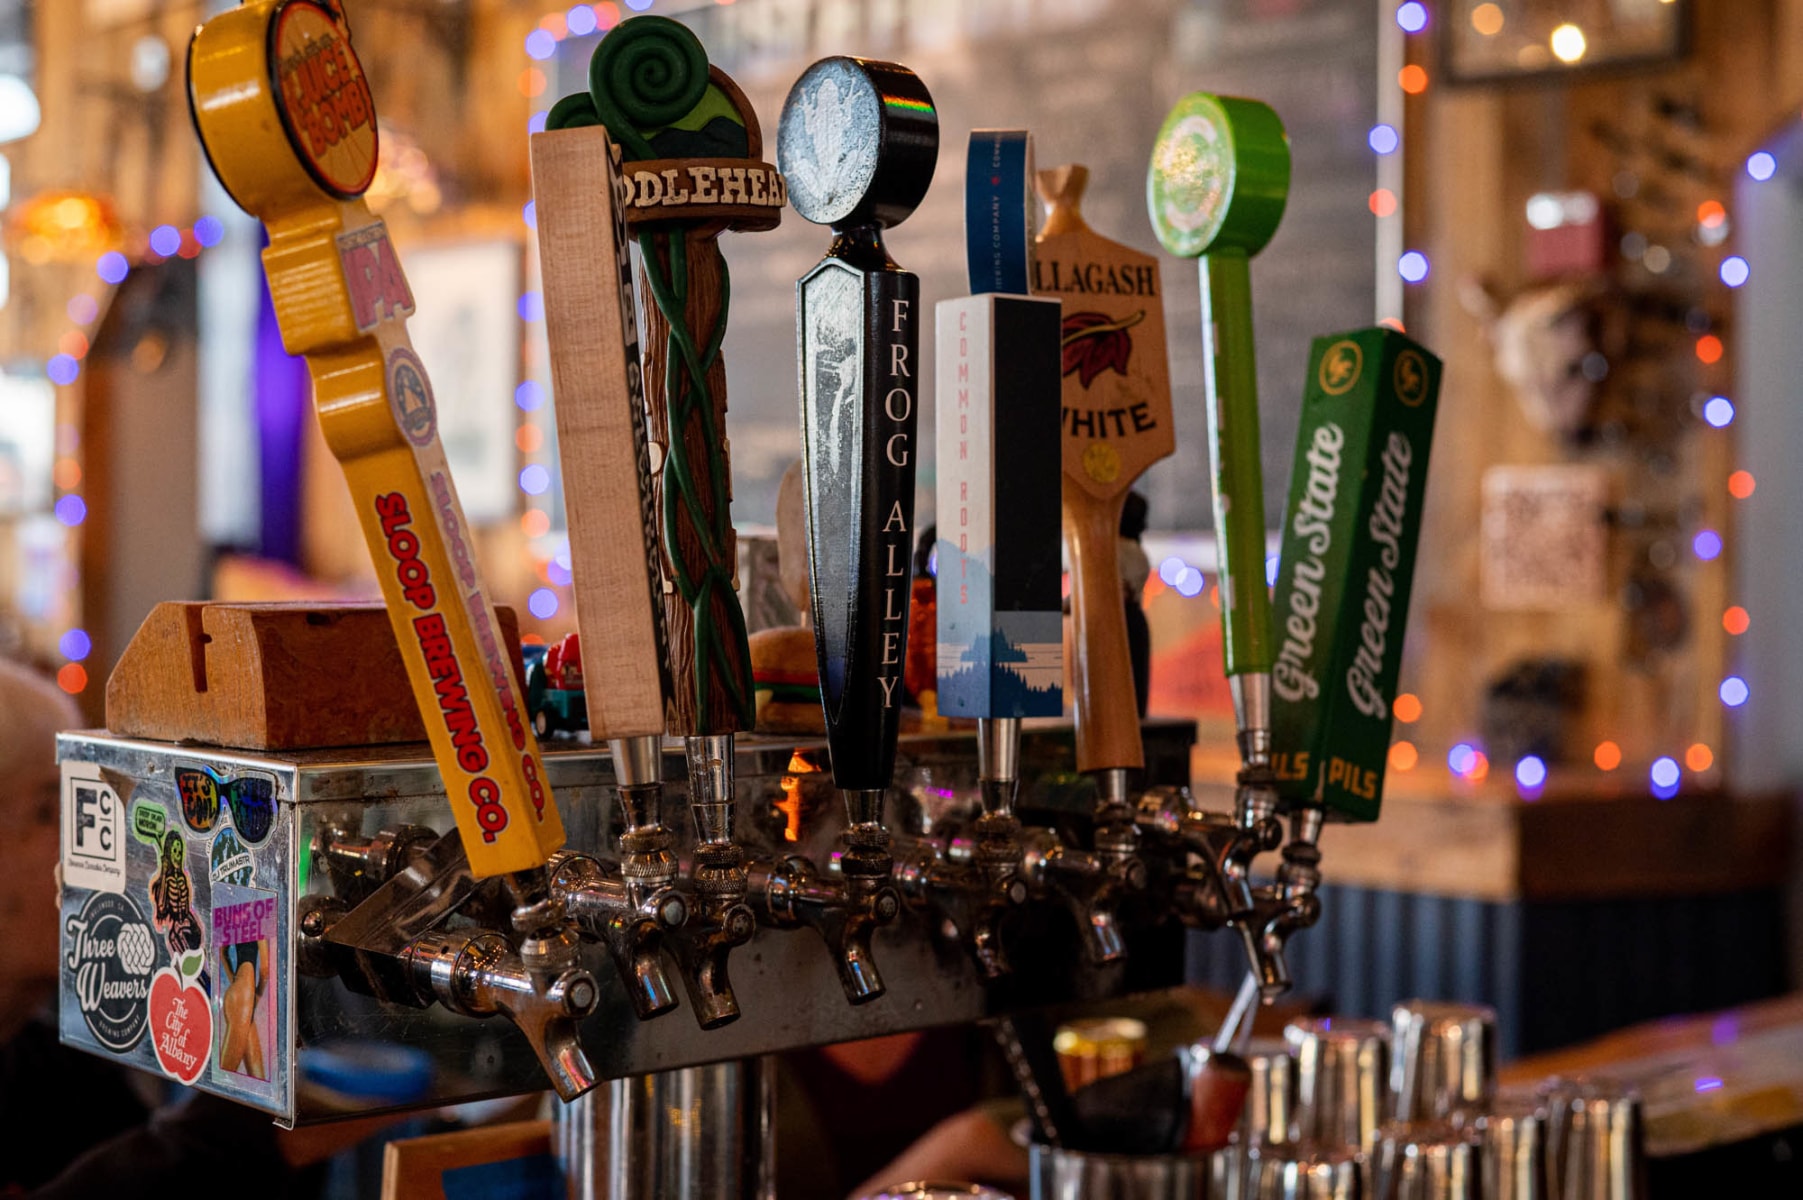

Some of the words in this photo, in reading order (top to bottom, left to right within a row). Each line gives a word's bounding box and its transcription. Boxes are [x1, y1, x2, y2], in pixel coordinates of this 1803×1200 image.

[306, 81, 368, 157] BOMB
[992, 196, 1000, 249] COMPANY
[342, 236, 413, 330] IPA
[884, 299, 911, 468] FROG
[957, 311, 970, 461] COMMON
[1293, 421, 1345, 555] State
[1369, 430, 1412, 571] State
[958, 481, 969, 606] ROOTS
[430, 470, 477, 590] SLOOP
[468, 590, 527, 753] BREWING
[521, 752, 545, 824] CO.
[876, 500, 907, 710] ALLEY
[1273, 553, 1326, 702] Green
[1346, 567, 1395, 721] Green
[375, 491, 437, 611] SLOOP
[413, 612, 490, 775] BREWING
[468, 776, 509, 845] CO.
[1328, 757, 1377, 800] PILS
[67, 919, 116, 970] Three
[213, 902, 252, 929] BUNS
[253, 898, 274, 921] OF
[221, 920, 265, 947] STEEL
[76, 962, 150, 1013] Weavers
[165, 1010, 184, 1038] City
[172, 997, 188, 1020] The
[159, 1032, 198, 1072] Albany
[177, 1028, 191, 1048] of
